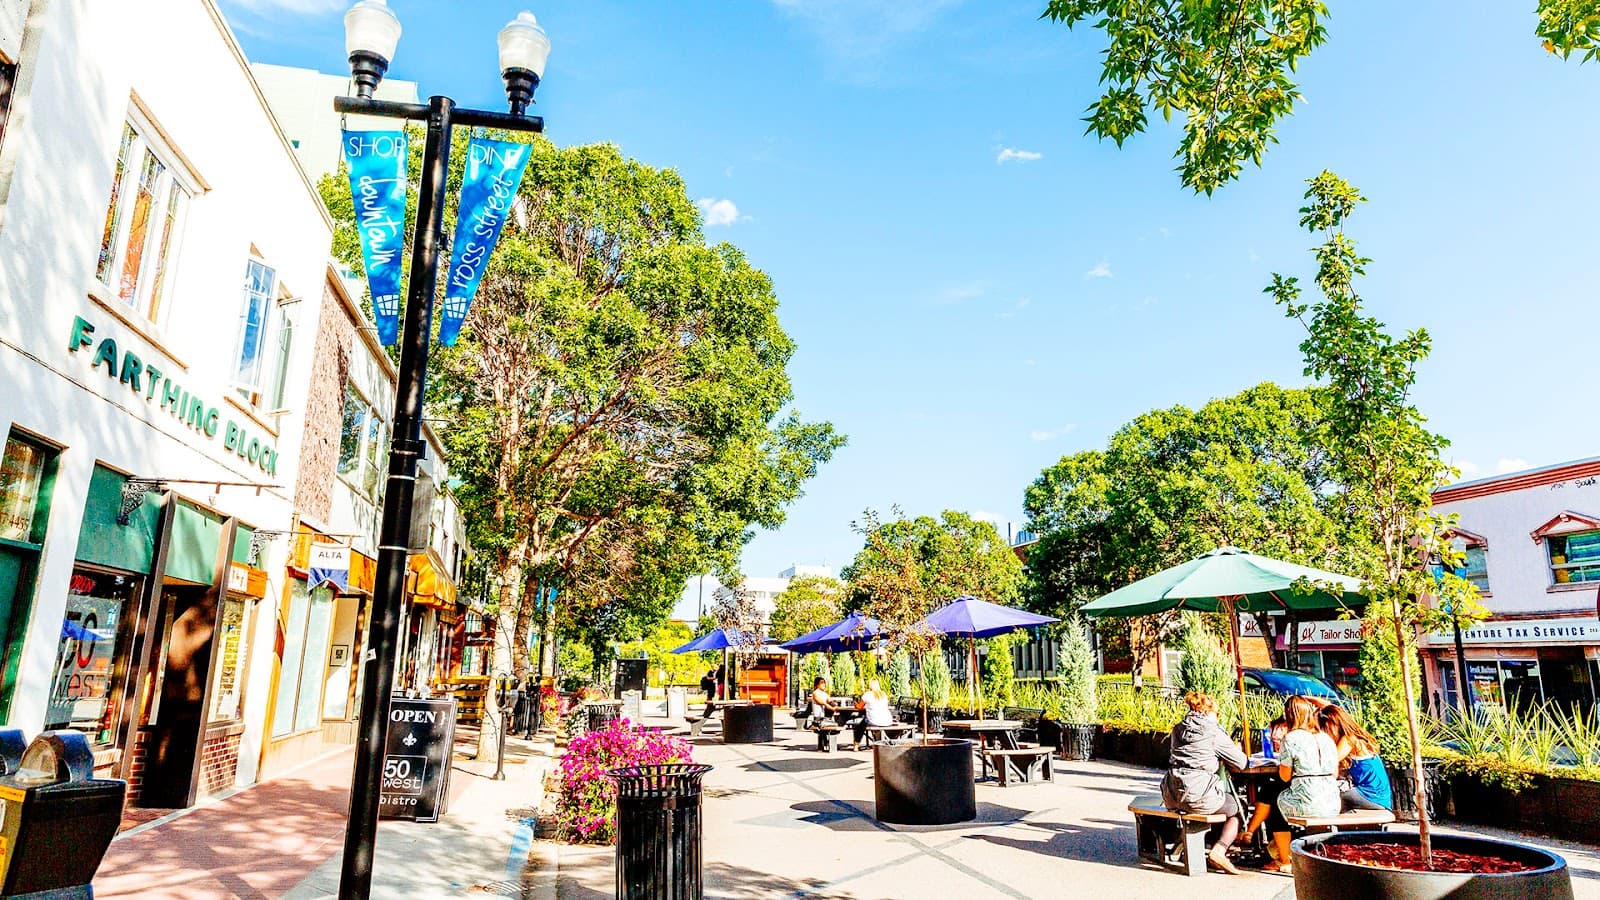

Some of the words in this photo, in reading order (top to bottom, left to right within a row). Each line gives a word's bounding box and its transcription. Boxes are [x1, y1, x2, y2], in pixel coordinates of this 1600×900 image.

[347, 135, 407, 158] SHOP
[359, 175, 404, 271] downtown
[451, 242, 486, 289] ross
[473, 174, 514, 239] street
[68, 314, 220, 439] FARTHING
[223, 419, 279, 478] BLOCK
[318, 551, 342, 559] ALTA
[1319, 628, 1342, 640] Tailor
[1343, 628, 1362, 639] Sho
[1460, 629, 1502, 639] ENTURE
[390, 709, 437, 723] OPEN
[384, 760, 411, 779] 50
[383, 777, 421, 789] west
[379, 795, 418, 806] bistro
